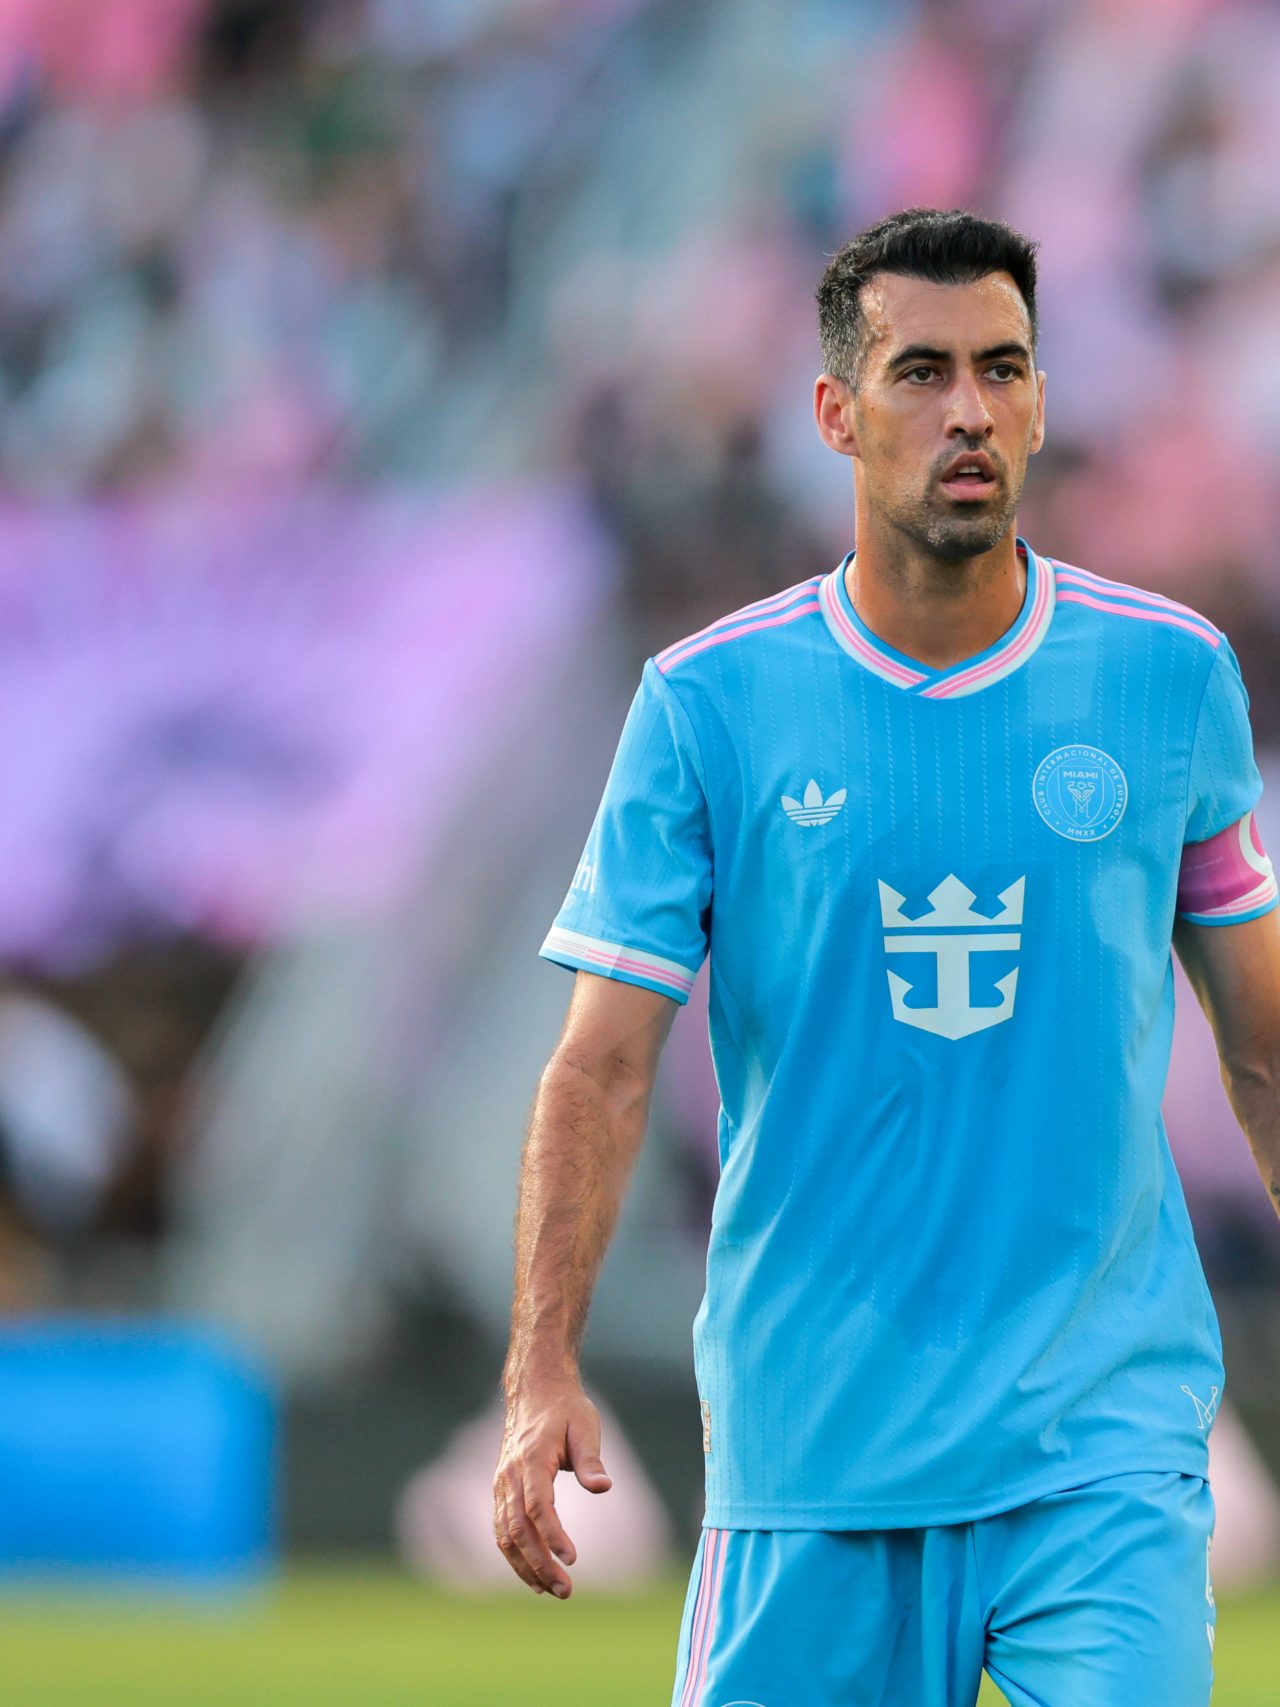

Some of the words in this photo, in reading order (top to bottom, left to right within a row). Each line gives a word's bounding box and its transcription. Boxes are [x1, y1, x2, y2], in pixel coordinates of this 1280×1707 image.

[1038, 749, 1109, 786] INTERNACIONAL
[1109, 767, 1120, 780] DE
[1063, 770, 1099, 780] MIAMI
[1038, 790, 1051, 816] CLUB
[1067, 827, 1096, 837] MMXX
